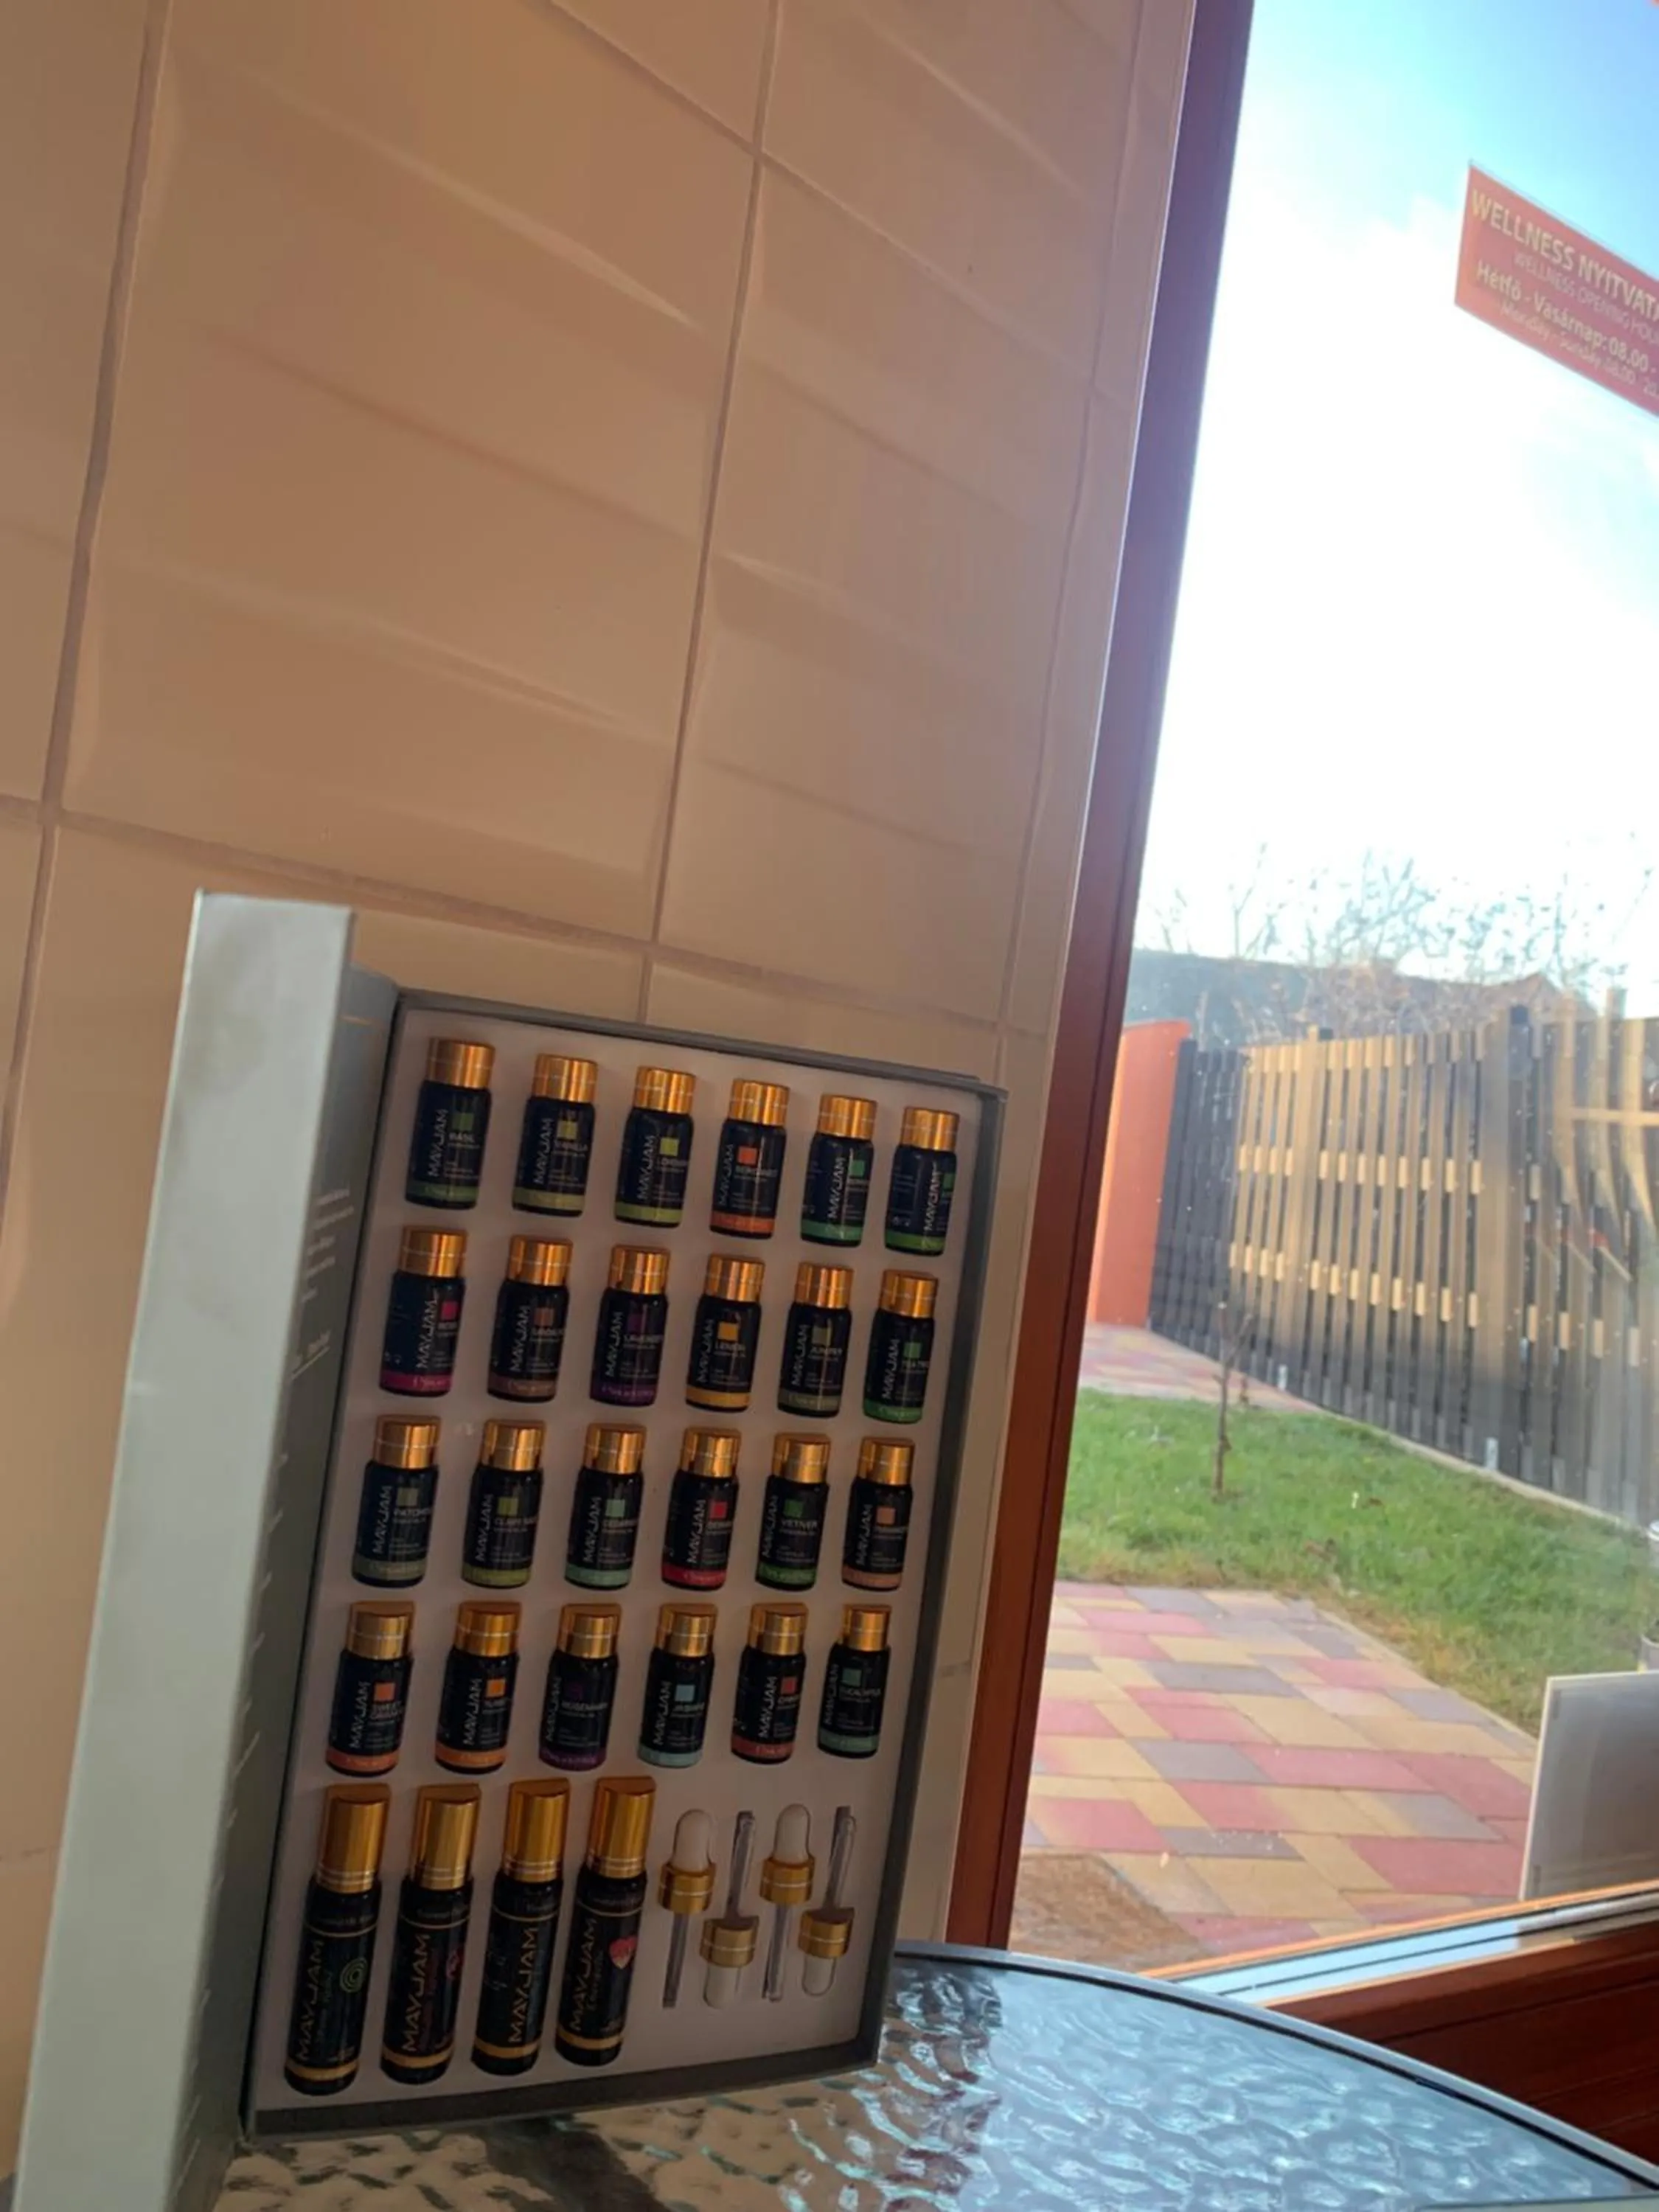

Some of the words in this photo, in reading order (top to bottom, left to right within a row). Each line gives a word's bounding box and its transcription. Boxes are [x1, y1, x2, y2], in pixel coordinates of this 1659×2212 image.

[1472, 188, 1575, 271] WELLNESS
[426, 1107, 449, 1178] MAYJAM
[532, 1116, 553, 1185] MAYJAM
[636, 1134, 657, 1201] MAYJAM
[827, 1156, 846, 1220] MAYJAM
[416, 1299, 438, 1369] MAYJAM
[509, 1304, 530, 1372] MAYJAM
[790, 1324, 810, 1386] MAYJAM
[881, 1338, 900, 1400] MAYJAM
[372, 1485, 392, 1554] MAYJAM
[474, 1492, 495, 1562] MAYJAM
[582, 1496, 602, 1563] MAYJAM
[686, 1498, 706, 1564] MAYJAM
[855, 1503, 873, 1566] MAYJAM
[348, 1680, 372, 1750] MAYJAM
[462, 1677, 484, 1746] MAYJAM
[652, 1680, 672, 1747] MAYJAM
[757, 1675, 778, 1739] MAYJAM
[296, 1939, 325, 2062] MAYJAM
[400, 1933, 431, 2053] MAYJAM
[507, 1926, 540, 2043] MAYJAM
[568, 1918, 598, 2031] MAYJAM
